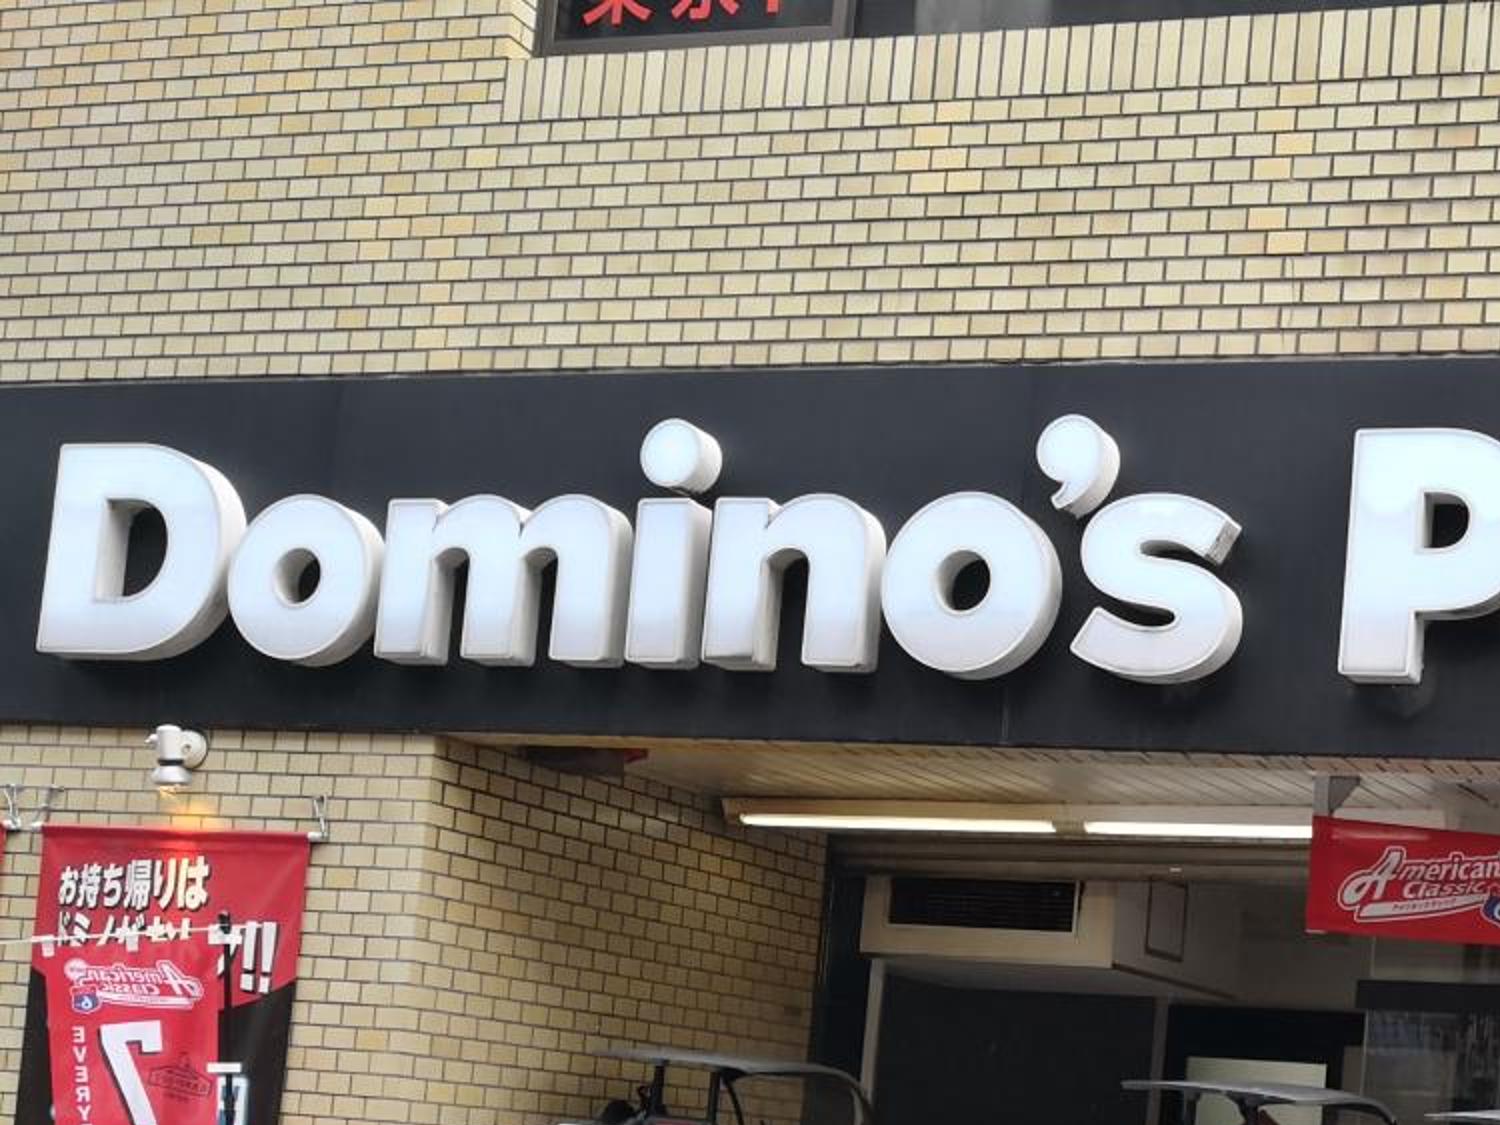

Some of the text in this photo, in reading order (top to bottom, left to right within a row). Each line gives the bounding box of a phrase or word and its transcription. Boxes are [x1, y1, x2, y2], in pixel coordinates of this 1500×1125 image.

[37, 413, 1244, 686] Domino's
[58, 856, 212, 911] お持ち帰りは
[1340, 848, 1500, 906] American
[1402, 880, 1486, 899] Classic
